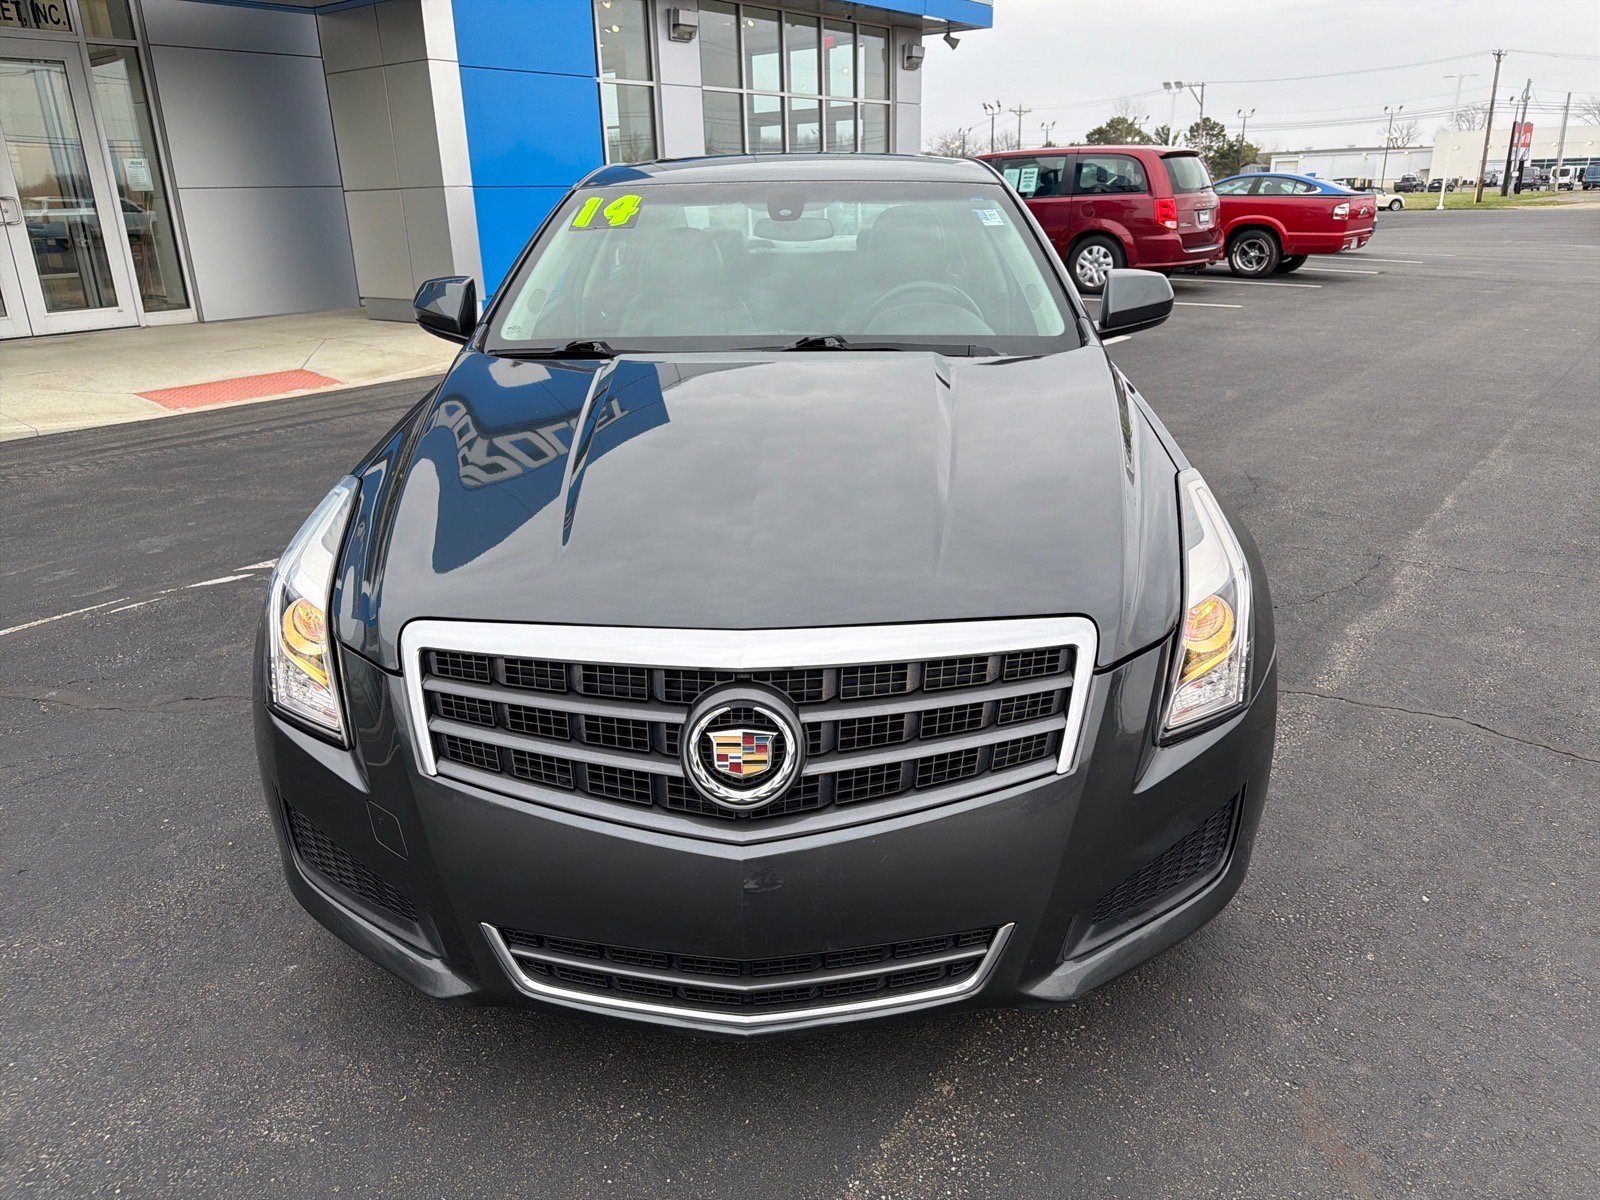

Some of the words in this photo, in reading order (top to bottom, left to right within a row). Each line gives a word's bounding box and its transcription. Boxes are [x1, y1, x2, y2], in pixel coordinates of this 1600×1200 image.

[0, 0, 27, 27] ET,
[31, 1, 66, 25] INC.
[572, 195, 642, 227] 14
